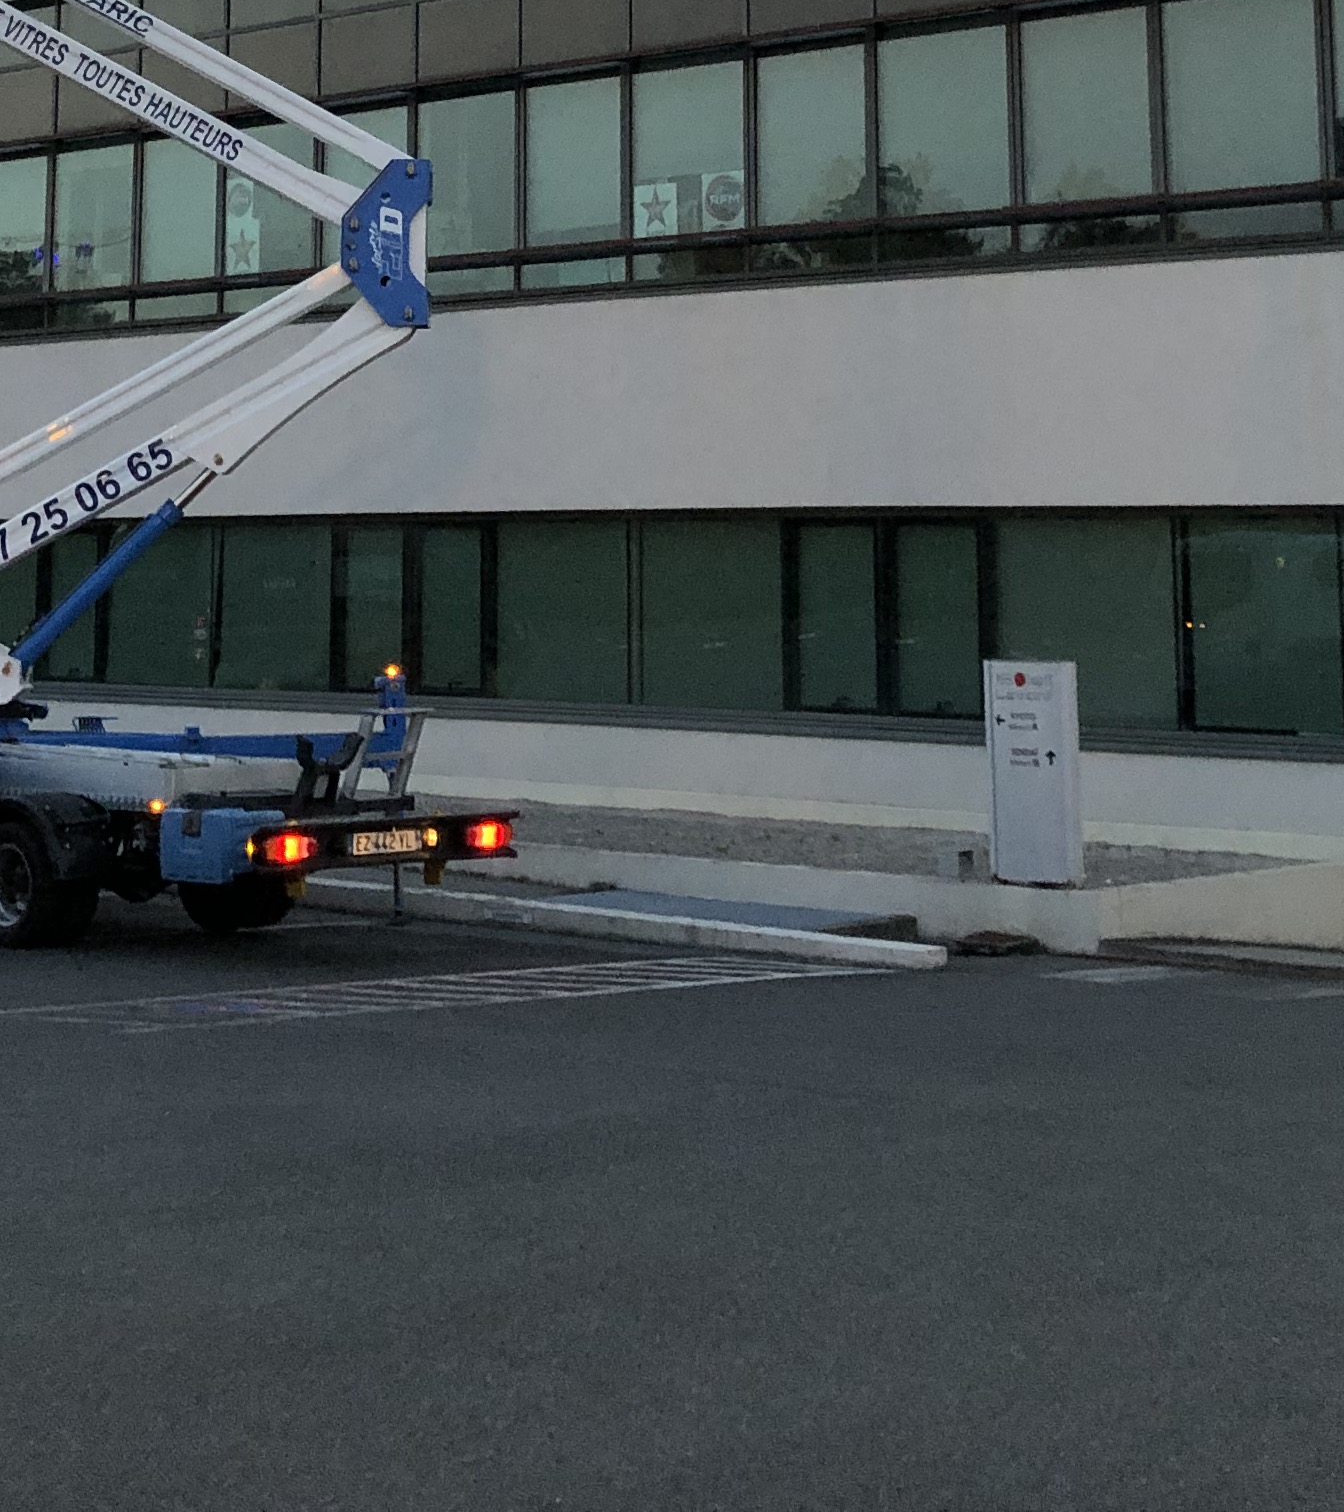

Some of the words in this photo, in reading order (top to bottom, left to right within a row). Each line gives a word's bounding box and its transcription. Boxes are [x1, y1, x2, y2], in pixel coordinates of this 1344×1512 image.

[4, 15, 70, 66] VITRES
[73, 53, 146, 107] TOUTES
[143, 92, 244, 161] HAUTEURS
[21, 497, 69, 544] 25
[74, 470, 121, 512] 06
[127, 438, 173, 482] 65
